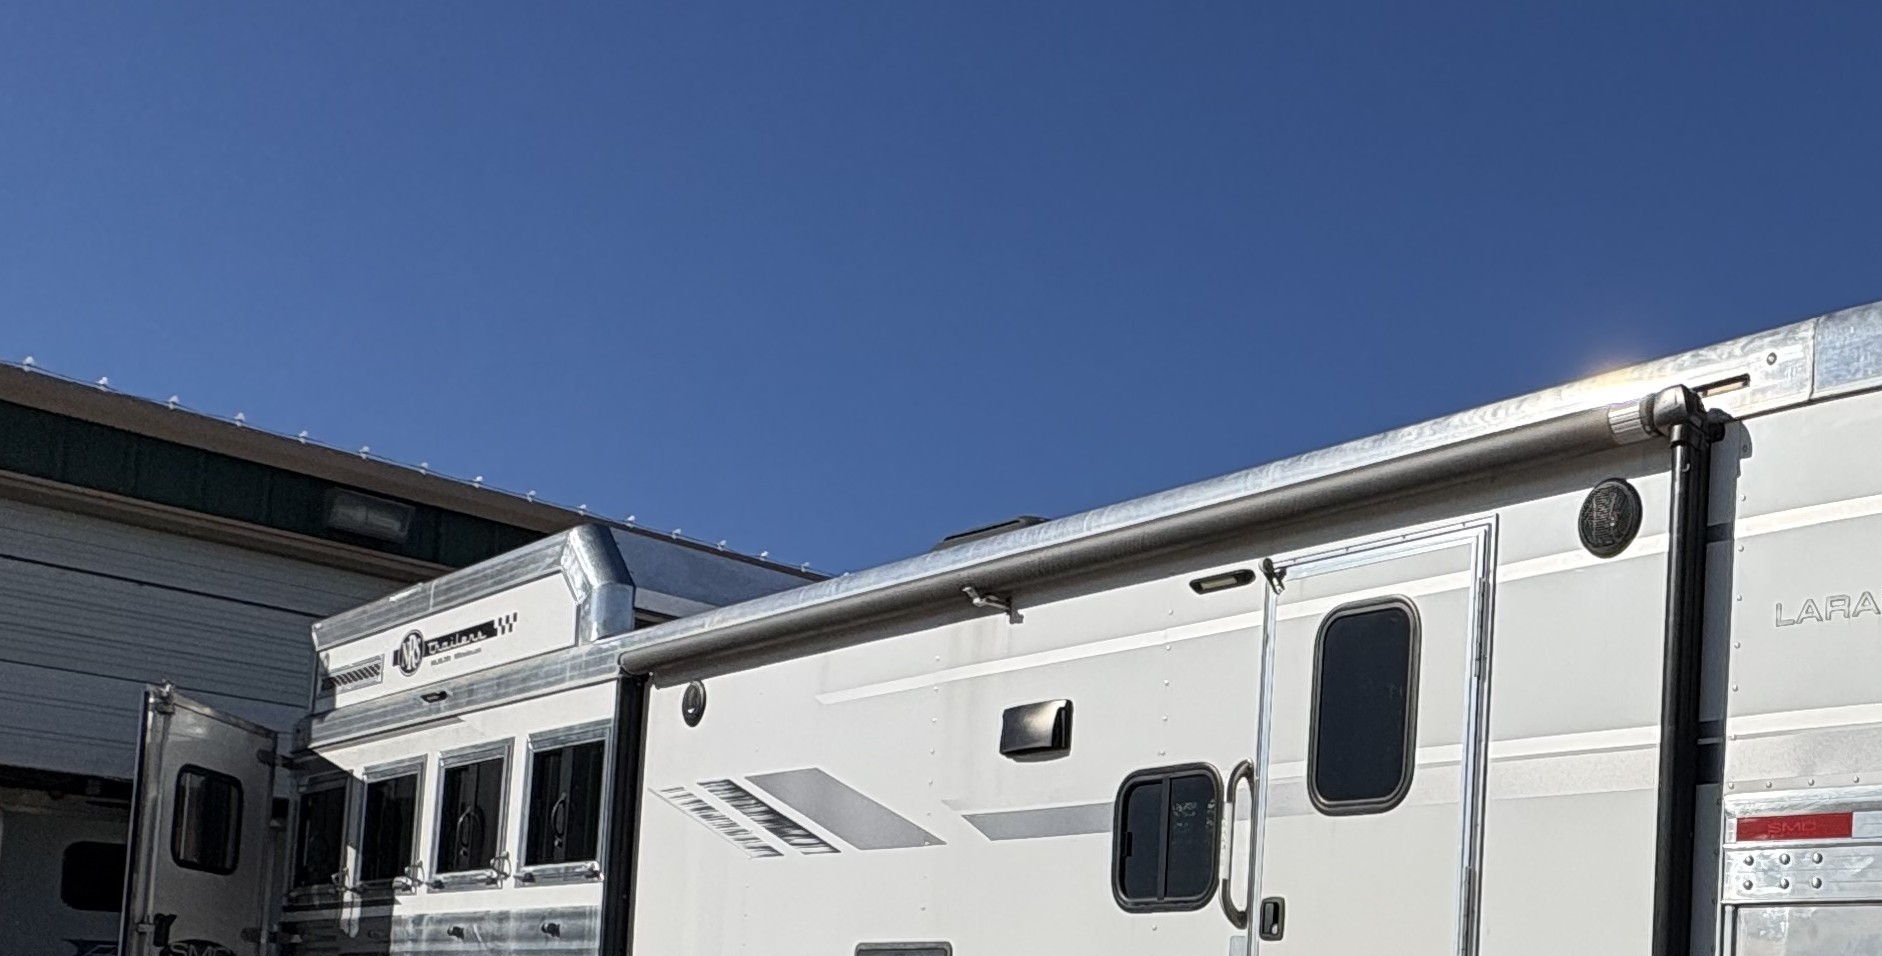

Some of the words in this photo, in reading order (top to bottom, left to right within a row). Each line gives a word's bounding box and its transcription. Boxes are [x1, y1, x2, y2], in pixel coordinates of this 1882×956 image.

[401, 633, 422, 671] NRS
[427, 630, 488, 654] Trailers
[1767, 820, 1817, 834] SMC
